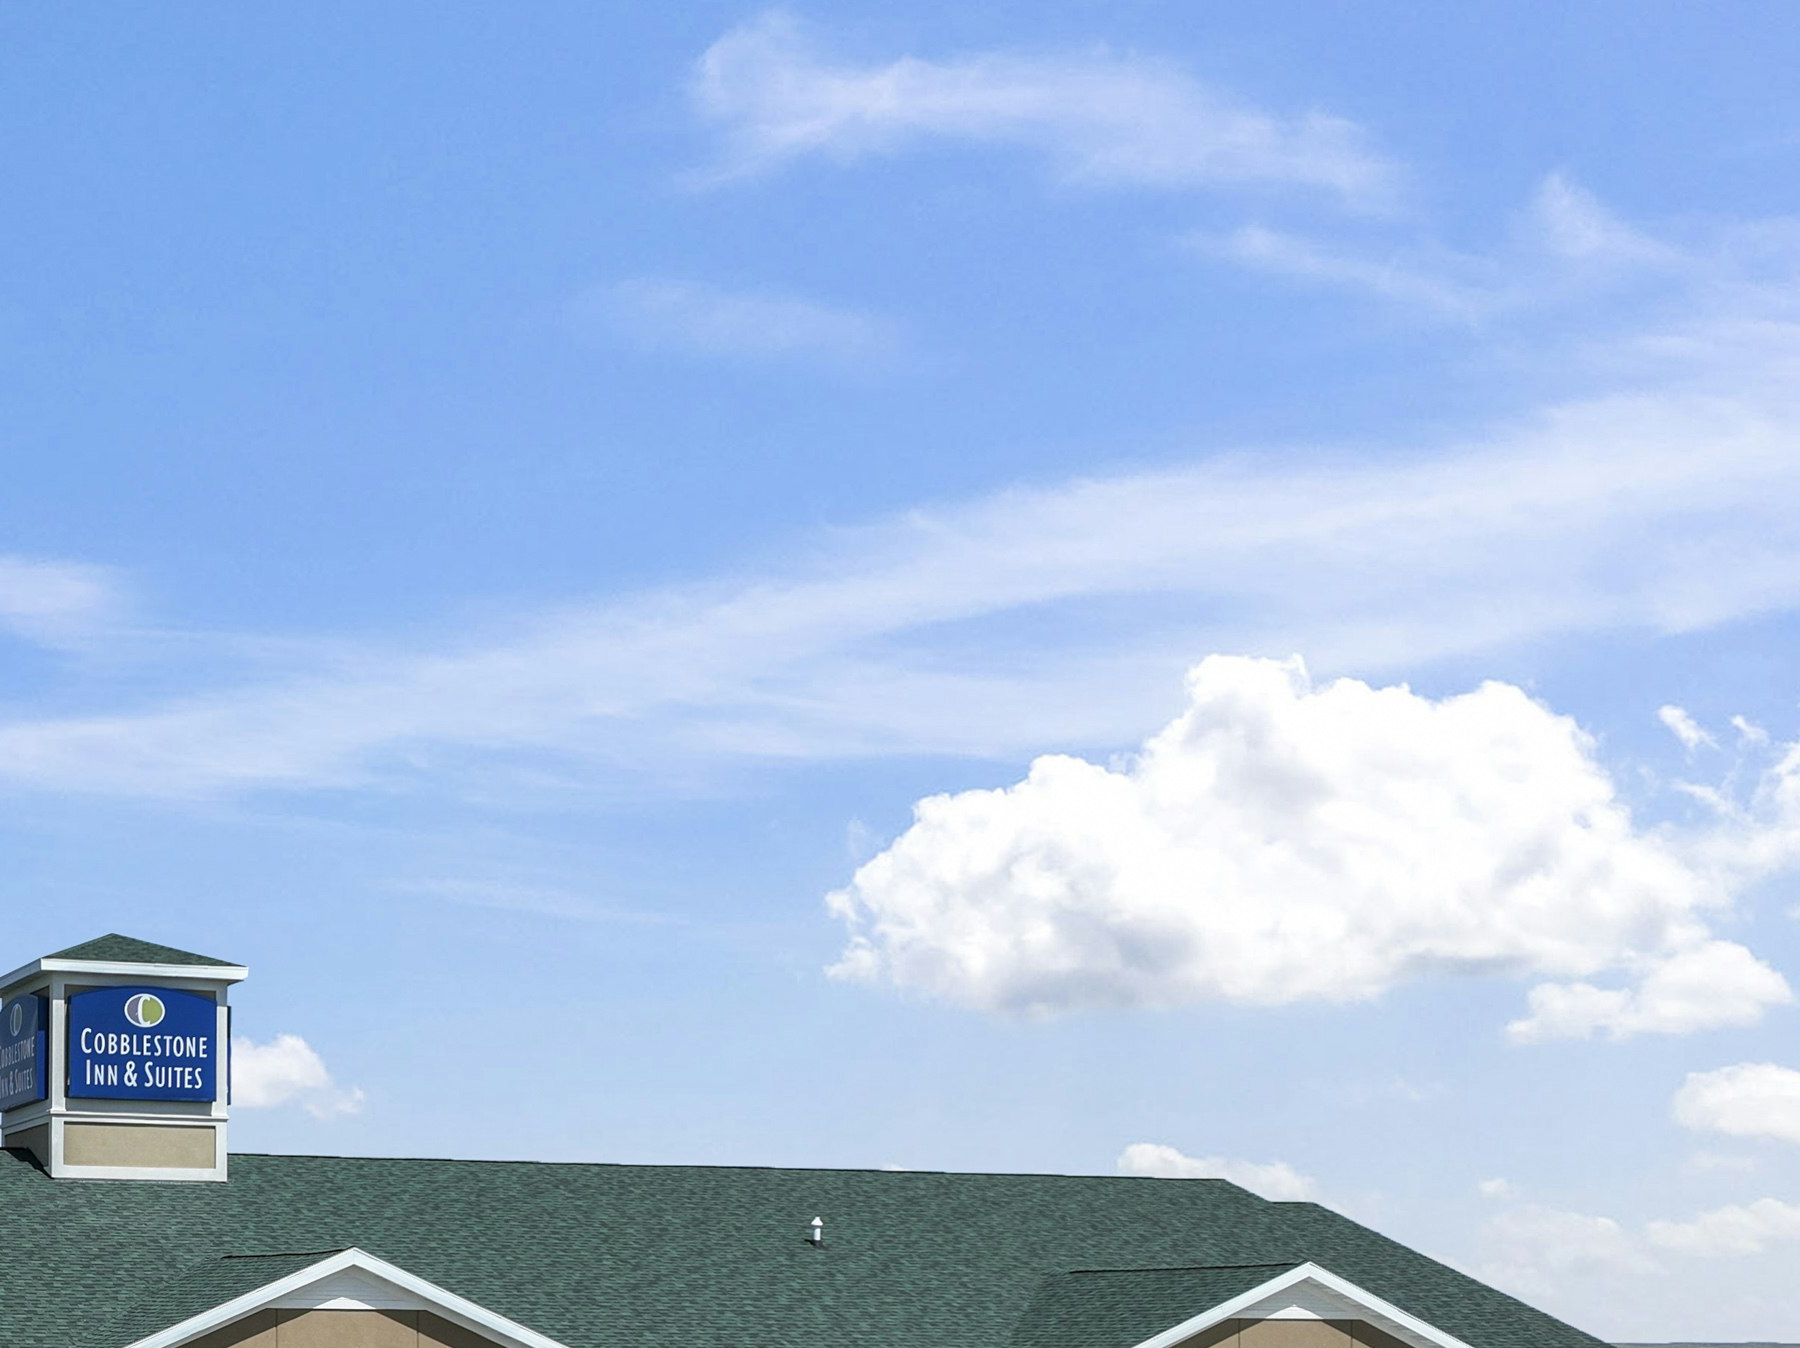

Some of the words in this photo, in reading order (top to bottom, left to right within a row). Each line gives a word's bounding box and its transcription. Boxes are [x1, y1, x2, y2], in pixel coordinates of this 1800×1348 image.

[81, 1027, 208, 1058] COBBLESTONE
[14, 1068, 33, 1094] SUITES
[86, 1059, 118, 1086] INN
[124, 1060, 138, 1087] &
[144, 1061, 203, 1089] SUITES
